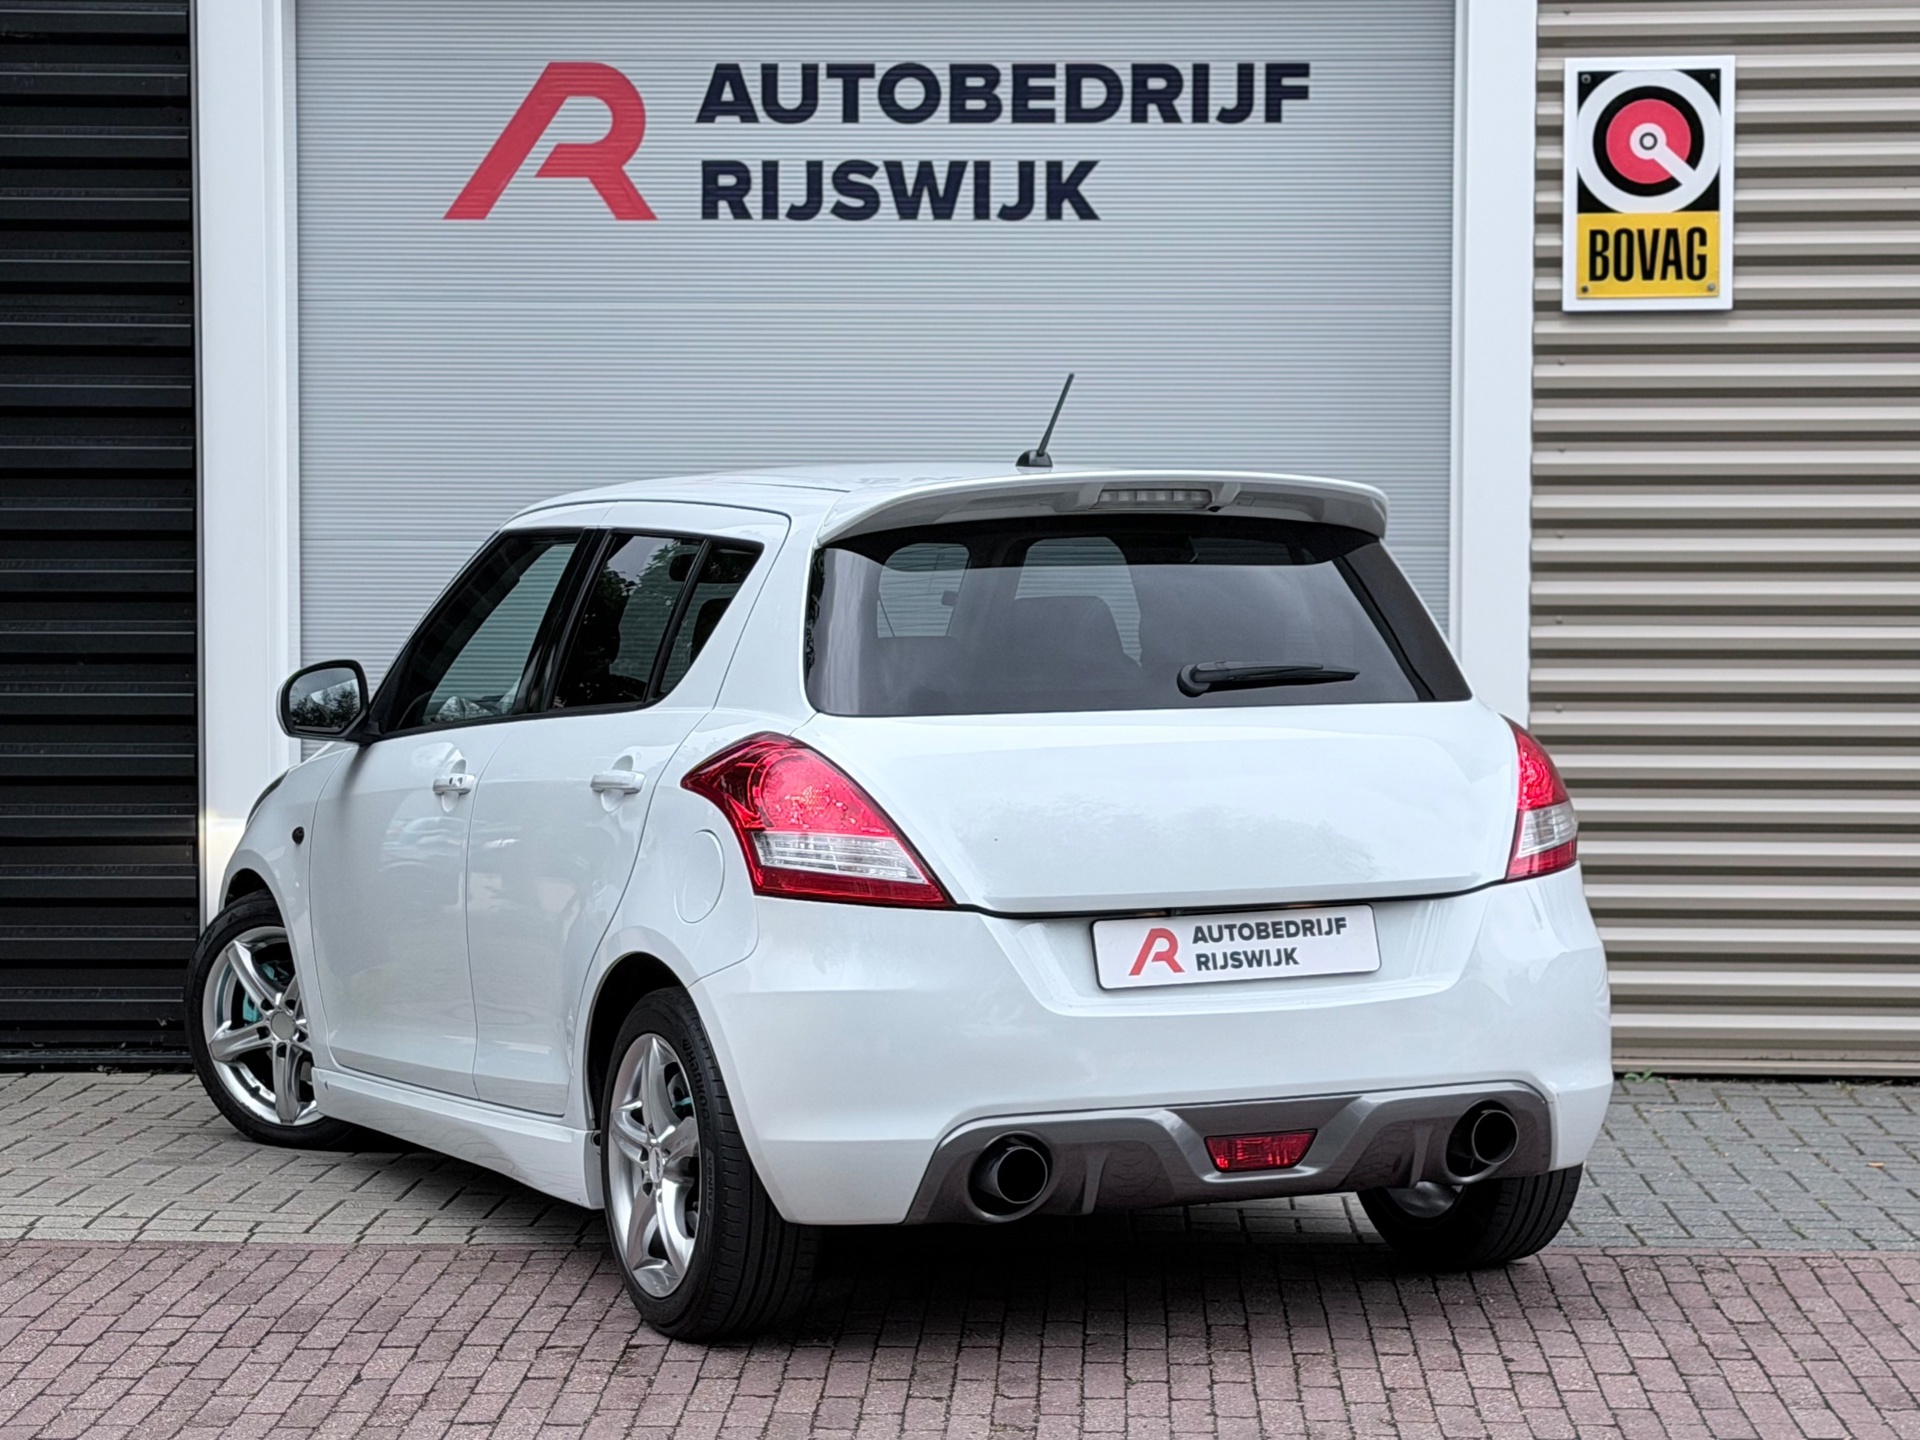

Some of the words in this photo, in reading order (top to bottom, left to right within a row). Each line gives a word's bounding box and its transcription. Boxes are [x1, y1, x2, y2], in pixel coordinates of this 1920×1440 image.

[696, 61, 1311, 125] AUTOBEDRIJF
[701, 159, 1101, 222] RIJSWIJK
[1588, 226, 1708, 283] BOVAG
[1192, 916, 1347, 944] AUTOBEDRIJF
[1196, 947, 1299, 971] RIJSWIJK
